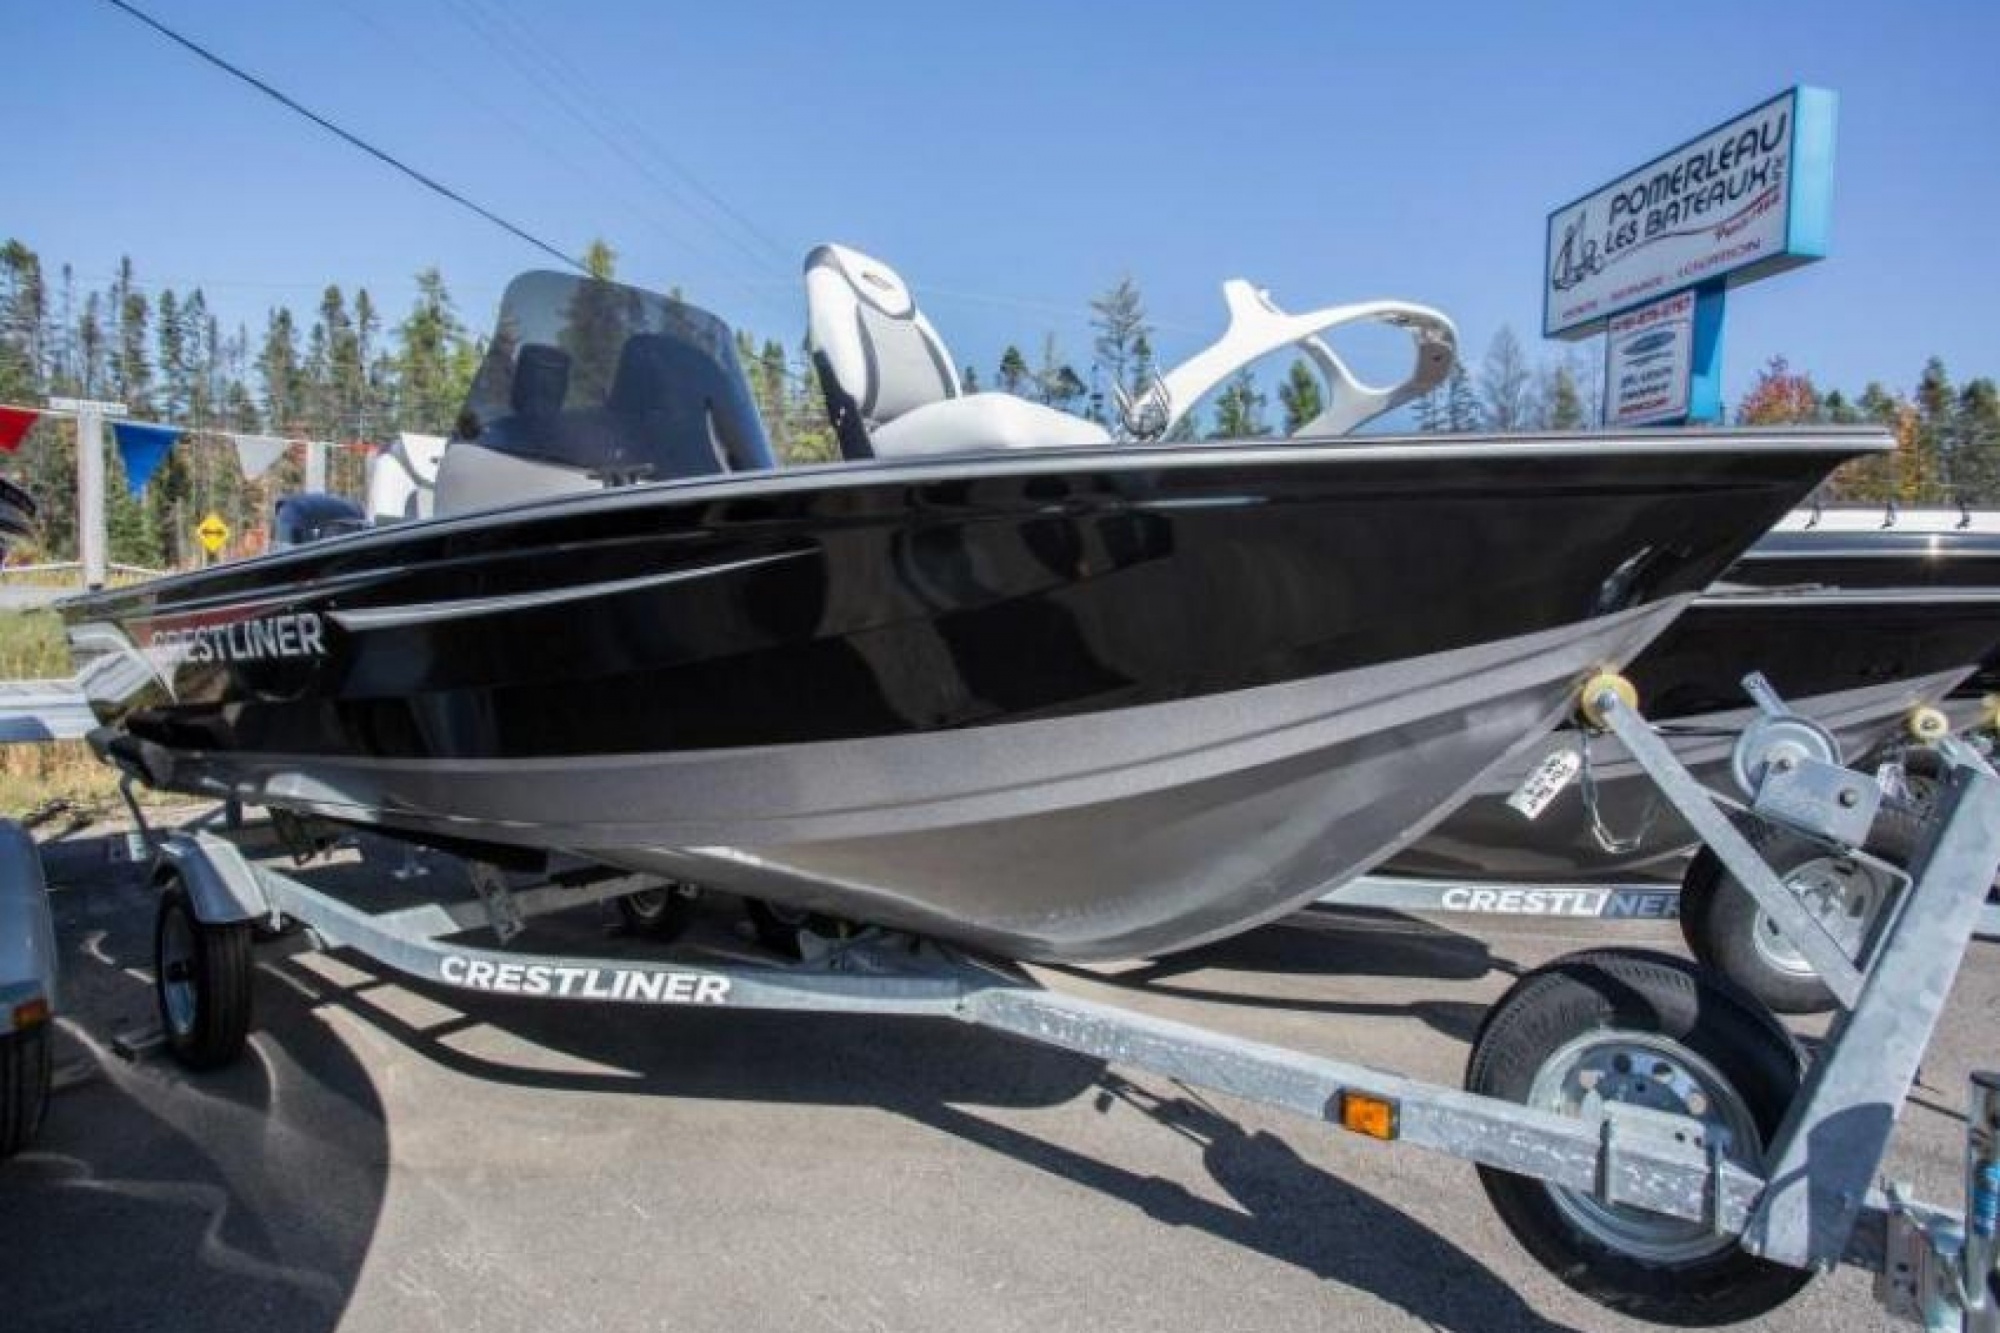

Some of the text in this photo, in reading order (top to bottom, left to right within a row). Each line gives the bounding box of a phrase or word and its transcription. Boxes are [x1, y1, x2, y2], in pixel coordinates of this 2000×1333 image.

[1605, 218, 1638, 254] LES
[1644, 157, 1771, 238] BATEAUX
[1608, 111, 1787, 226] POMERLEAU
[440, 955, 731, 1004] CRESTLINER
